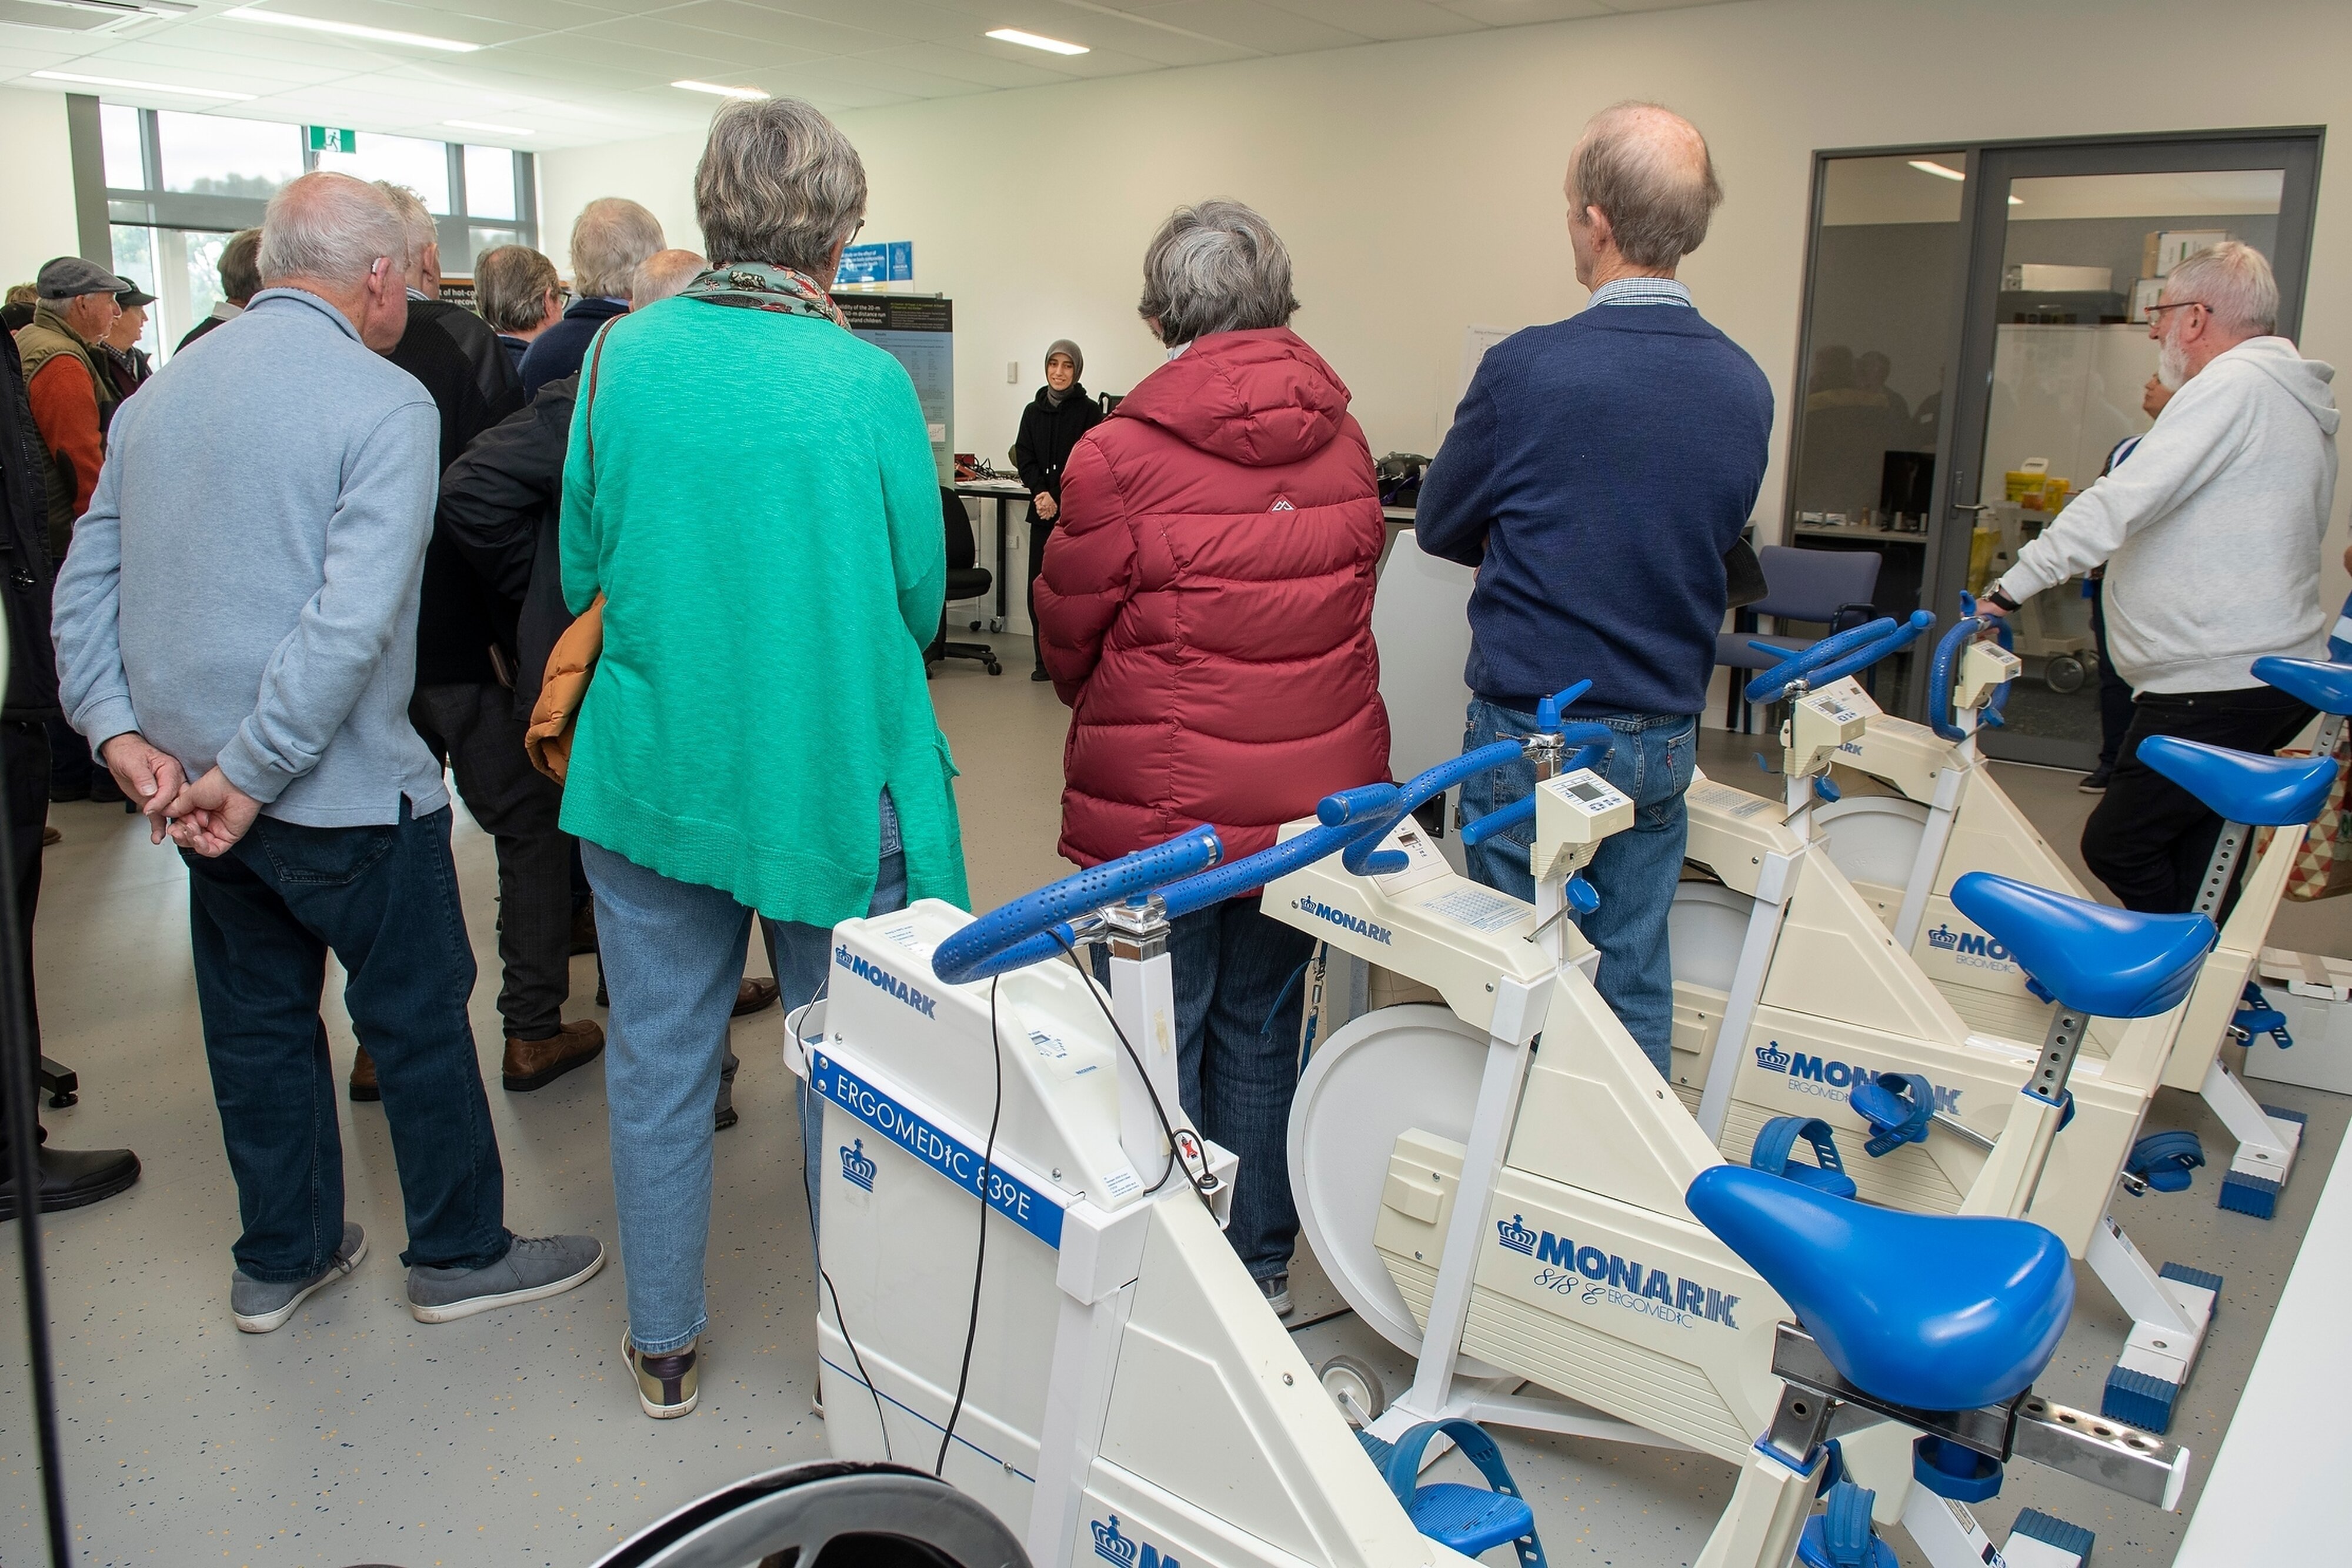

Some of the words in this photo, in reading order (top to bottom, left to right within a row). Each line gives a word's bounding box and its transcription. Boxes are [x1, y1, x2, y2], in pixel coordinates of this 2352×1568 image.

[443, 288, 451, 296] of
[452, 288, 475, 296] hot-co
[1315, 903, 1392, 946] MONARK
[852, 955, 936, 1021] MONARK
[1788, 1079, 1850, 1102] ERGOMEDI
[1789, 1052, 1963, 1116] MONK
[838, 1074, 969, 1179] ERGOMEDIC
[1533, 1267, 1579, 1295] 818
[1608, 1289, 1694, 1329] ERGOMEDIC
[1536, 1230, 1741, 1330] MONARK
